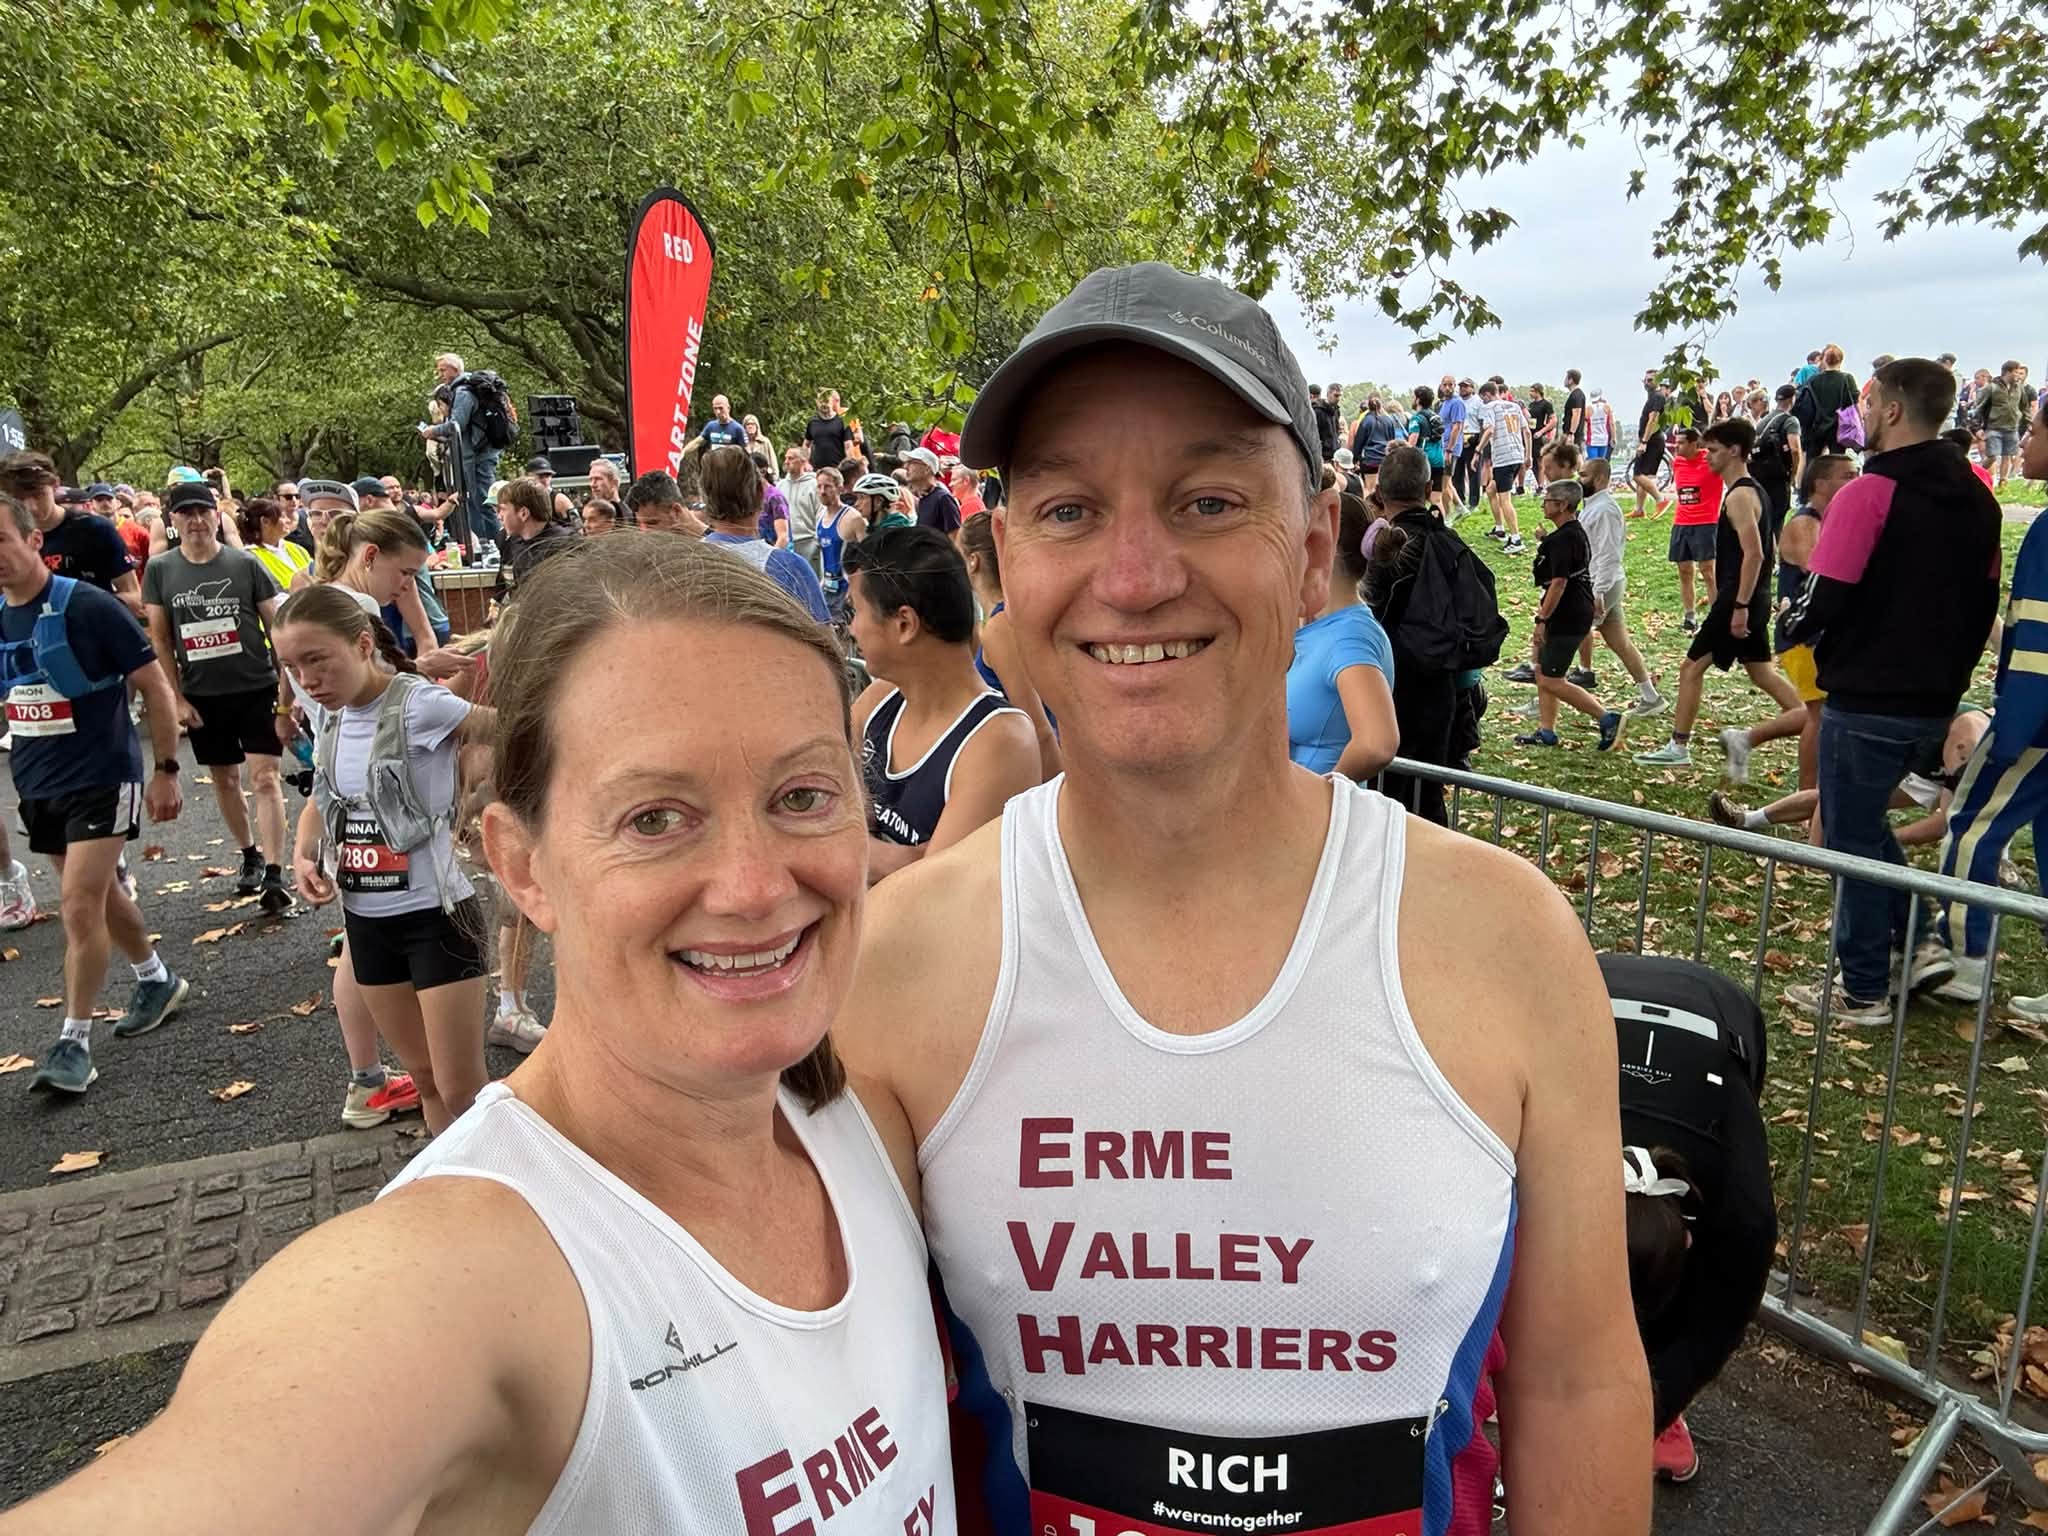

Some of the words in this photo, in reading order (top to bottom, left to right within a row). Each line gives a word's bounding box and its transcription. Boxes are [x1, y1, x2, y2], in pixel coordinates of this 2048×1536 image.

[663, 232, 694, 264] RED
[1190, 315, 1268, 367] Columbia
[663, 404, 689, 479] ART
[678, 315, 704, 401] ZONE
[206, 604, 240, 617] 2022
[192, 633, 230, 648] 12915
[15, 704, 53, 720] 1708
[345, 823, 381, 834] ANNA
[873, 803, 909, 838] EATON
[343, 847, 379, 869] 280
[1019, 1117, 1233, 1188] ERME
[1007, 1221, 1314, 1291] VALLEY
[1017, 1314, 1398, 1376] HARRIERS
[630, 1342, 738, 1391] RONHILL
[736, 1406, 898, 1536] ERME
[1168, 1447, 1288, 1493] RICH
[1152, 1500, 1303, 1532] #werantogether
